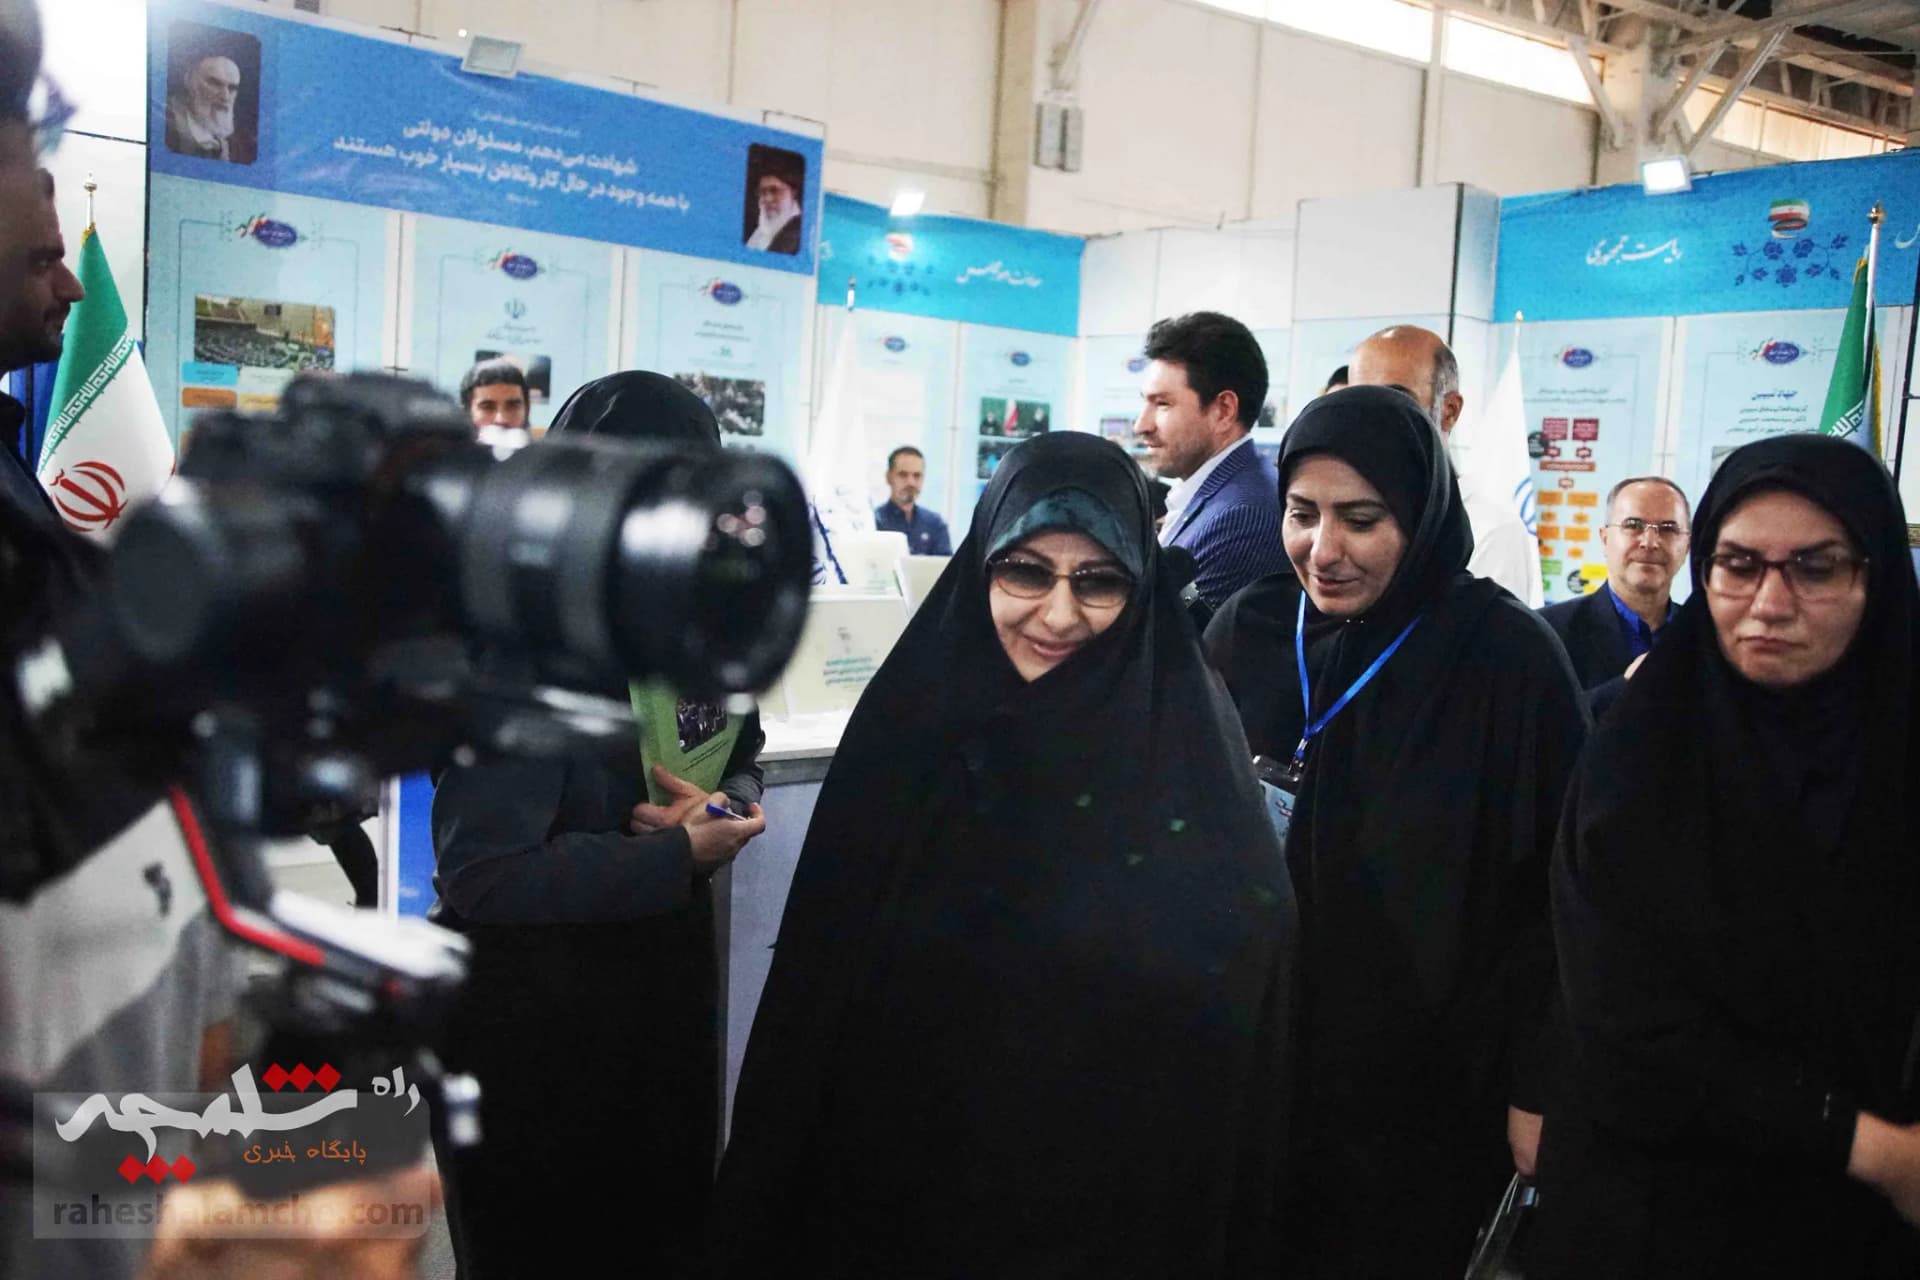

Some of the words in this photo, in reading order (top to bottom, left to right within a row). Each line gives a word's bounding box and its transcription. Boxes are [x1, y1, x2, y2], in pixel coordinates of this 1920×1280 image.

[333, 135, 397, 158] هستند
[400, 147, 439, 169] خوب
[1621, 236, 1684, 263] ریاست
